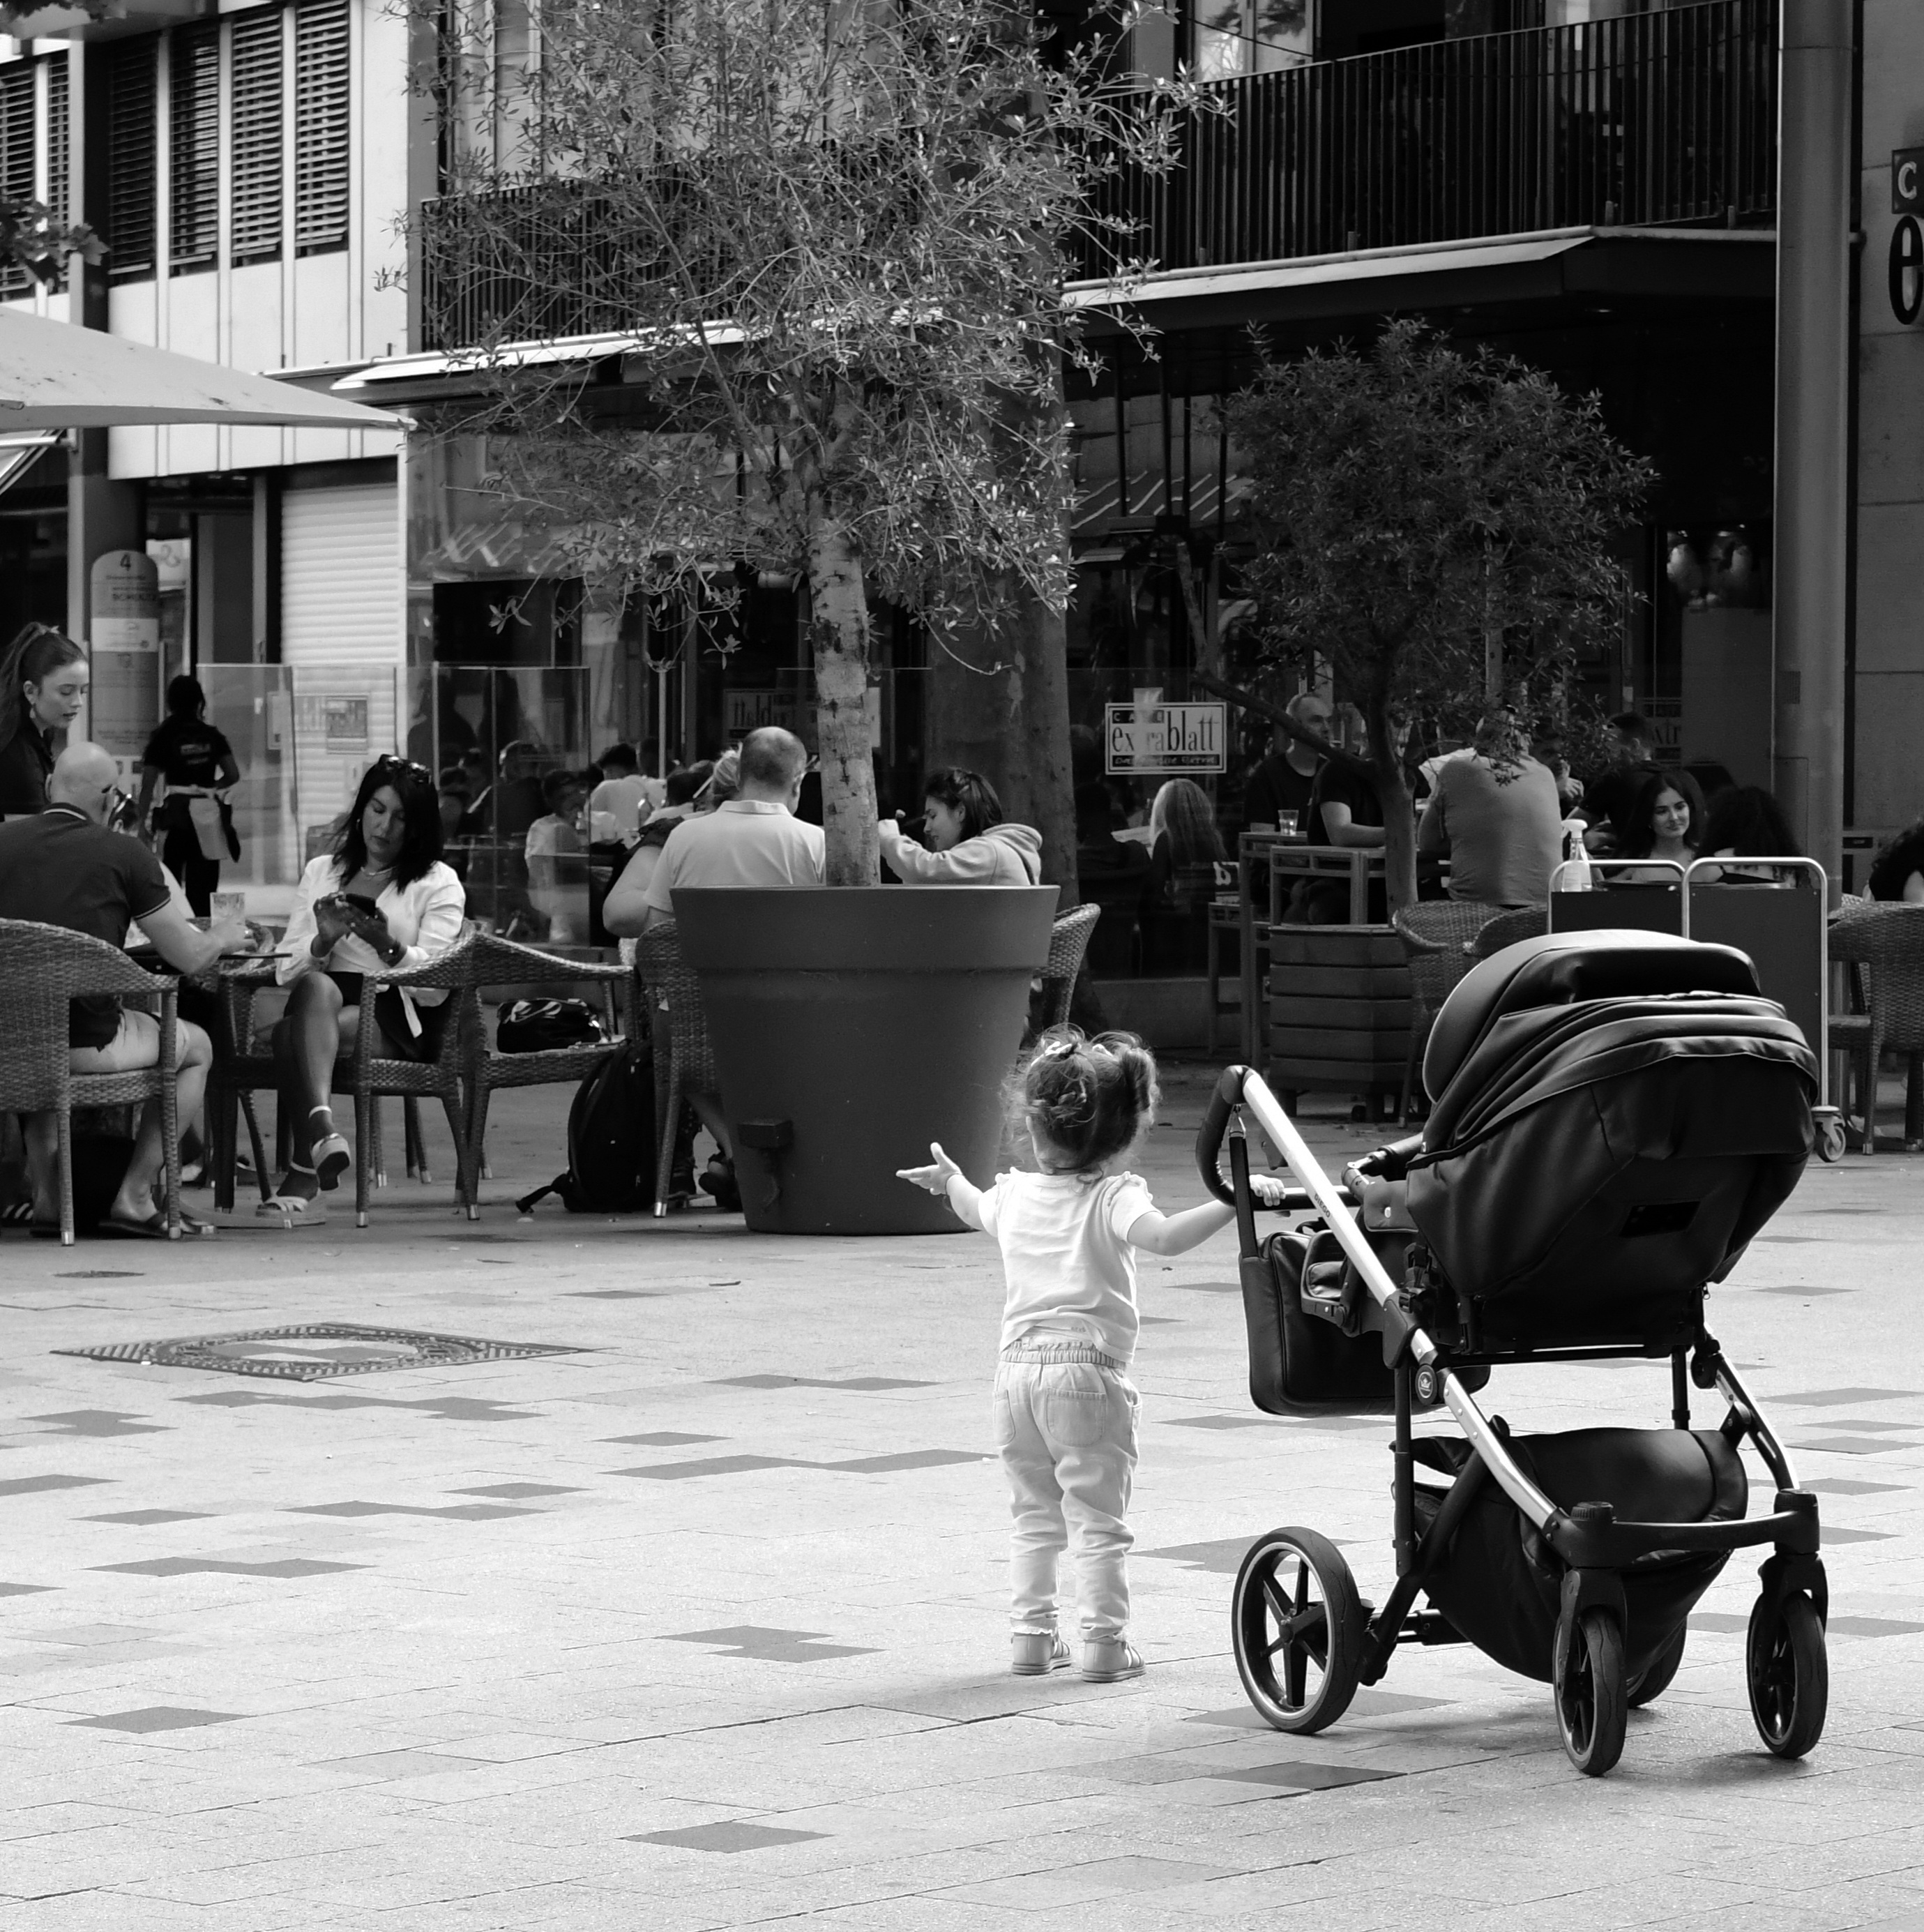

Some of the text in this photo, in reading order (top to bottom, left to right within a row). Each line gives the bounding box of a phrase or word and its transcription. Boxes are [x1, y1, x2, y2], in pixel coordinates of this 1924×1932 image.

[120, 553, 132, 572] 4
[1112, 710, 1220, 753] exrablatt
[1314, 1193, 1331, 1218] DIEGO
